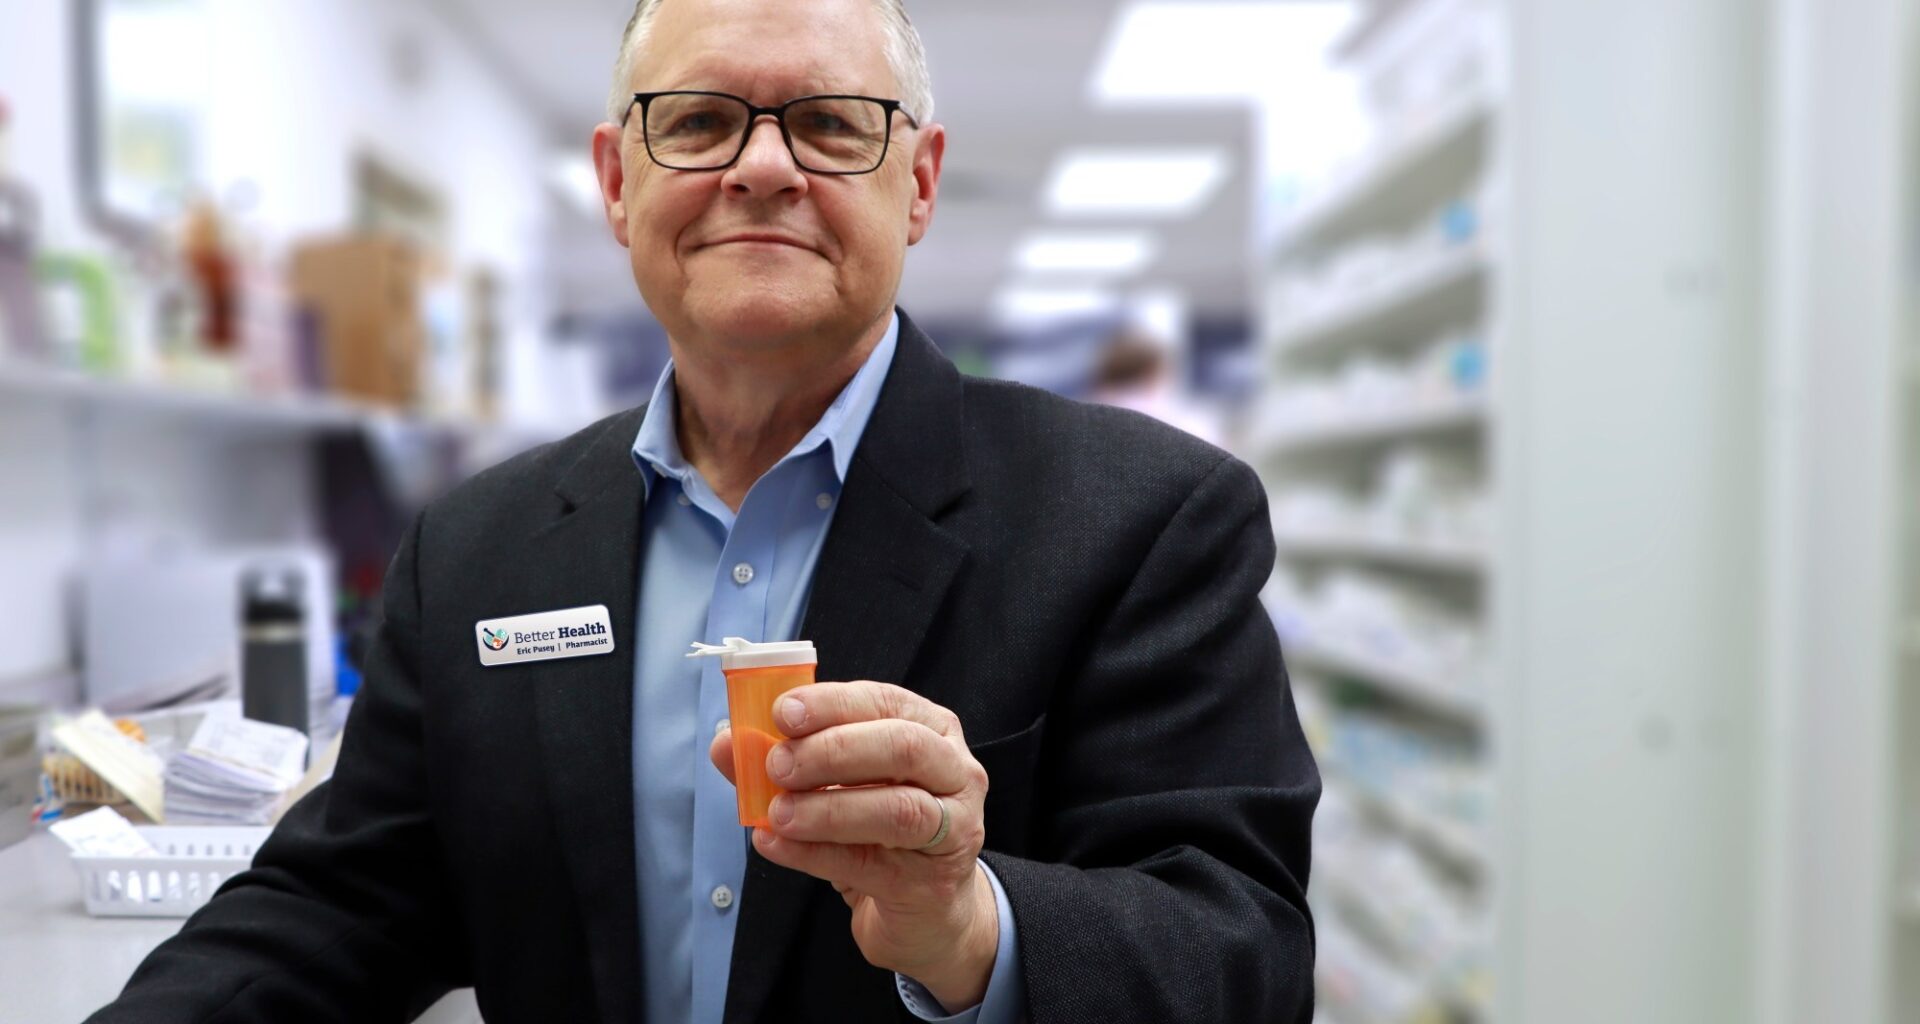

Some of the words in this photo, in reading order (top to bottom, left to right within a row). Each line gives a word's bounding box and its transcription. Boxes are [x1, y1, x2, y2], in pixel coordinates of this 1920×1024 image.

[514, 630, 555, 644] Better
[558, 622, 606, 639] Health
[517, 646, 531, 655] Eric
[533, 644, 555, 654] Pusey
[565, 638, 608, 649] Pharmacist
